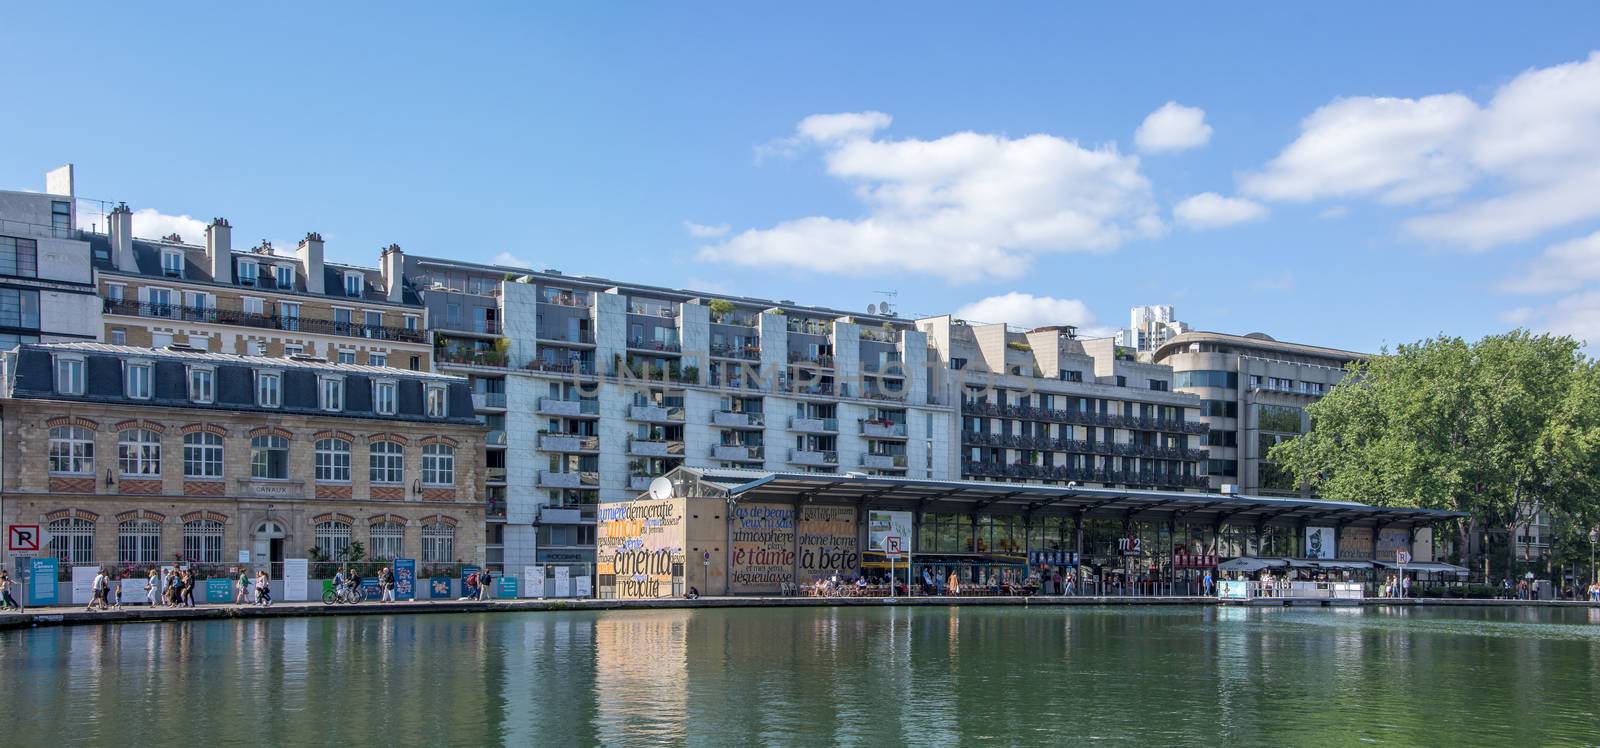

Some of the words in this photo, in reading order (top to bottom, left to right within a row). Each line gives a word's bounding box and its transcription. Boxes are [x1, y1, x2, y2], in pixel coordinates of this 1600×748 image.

[626, 501, 674, 520] démocratie
[18, 531, 31, 545] P
[799, 546, 815, 568] la
[818, 546, 857, 569] bête
